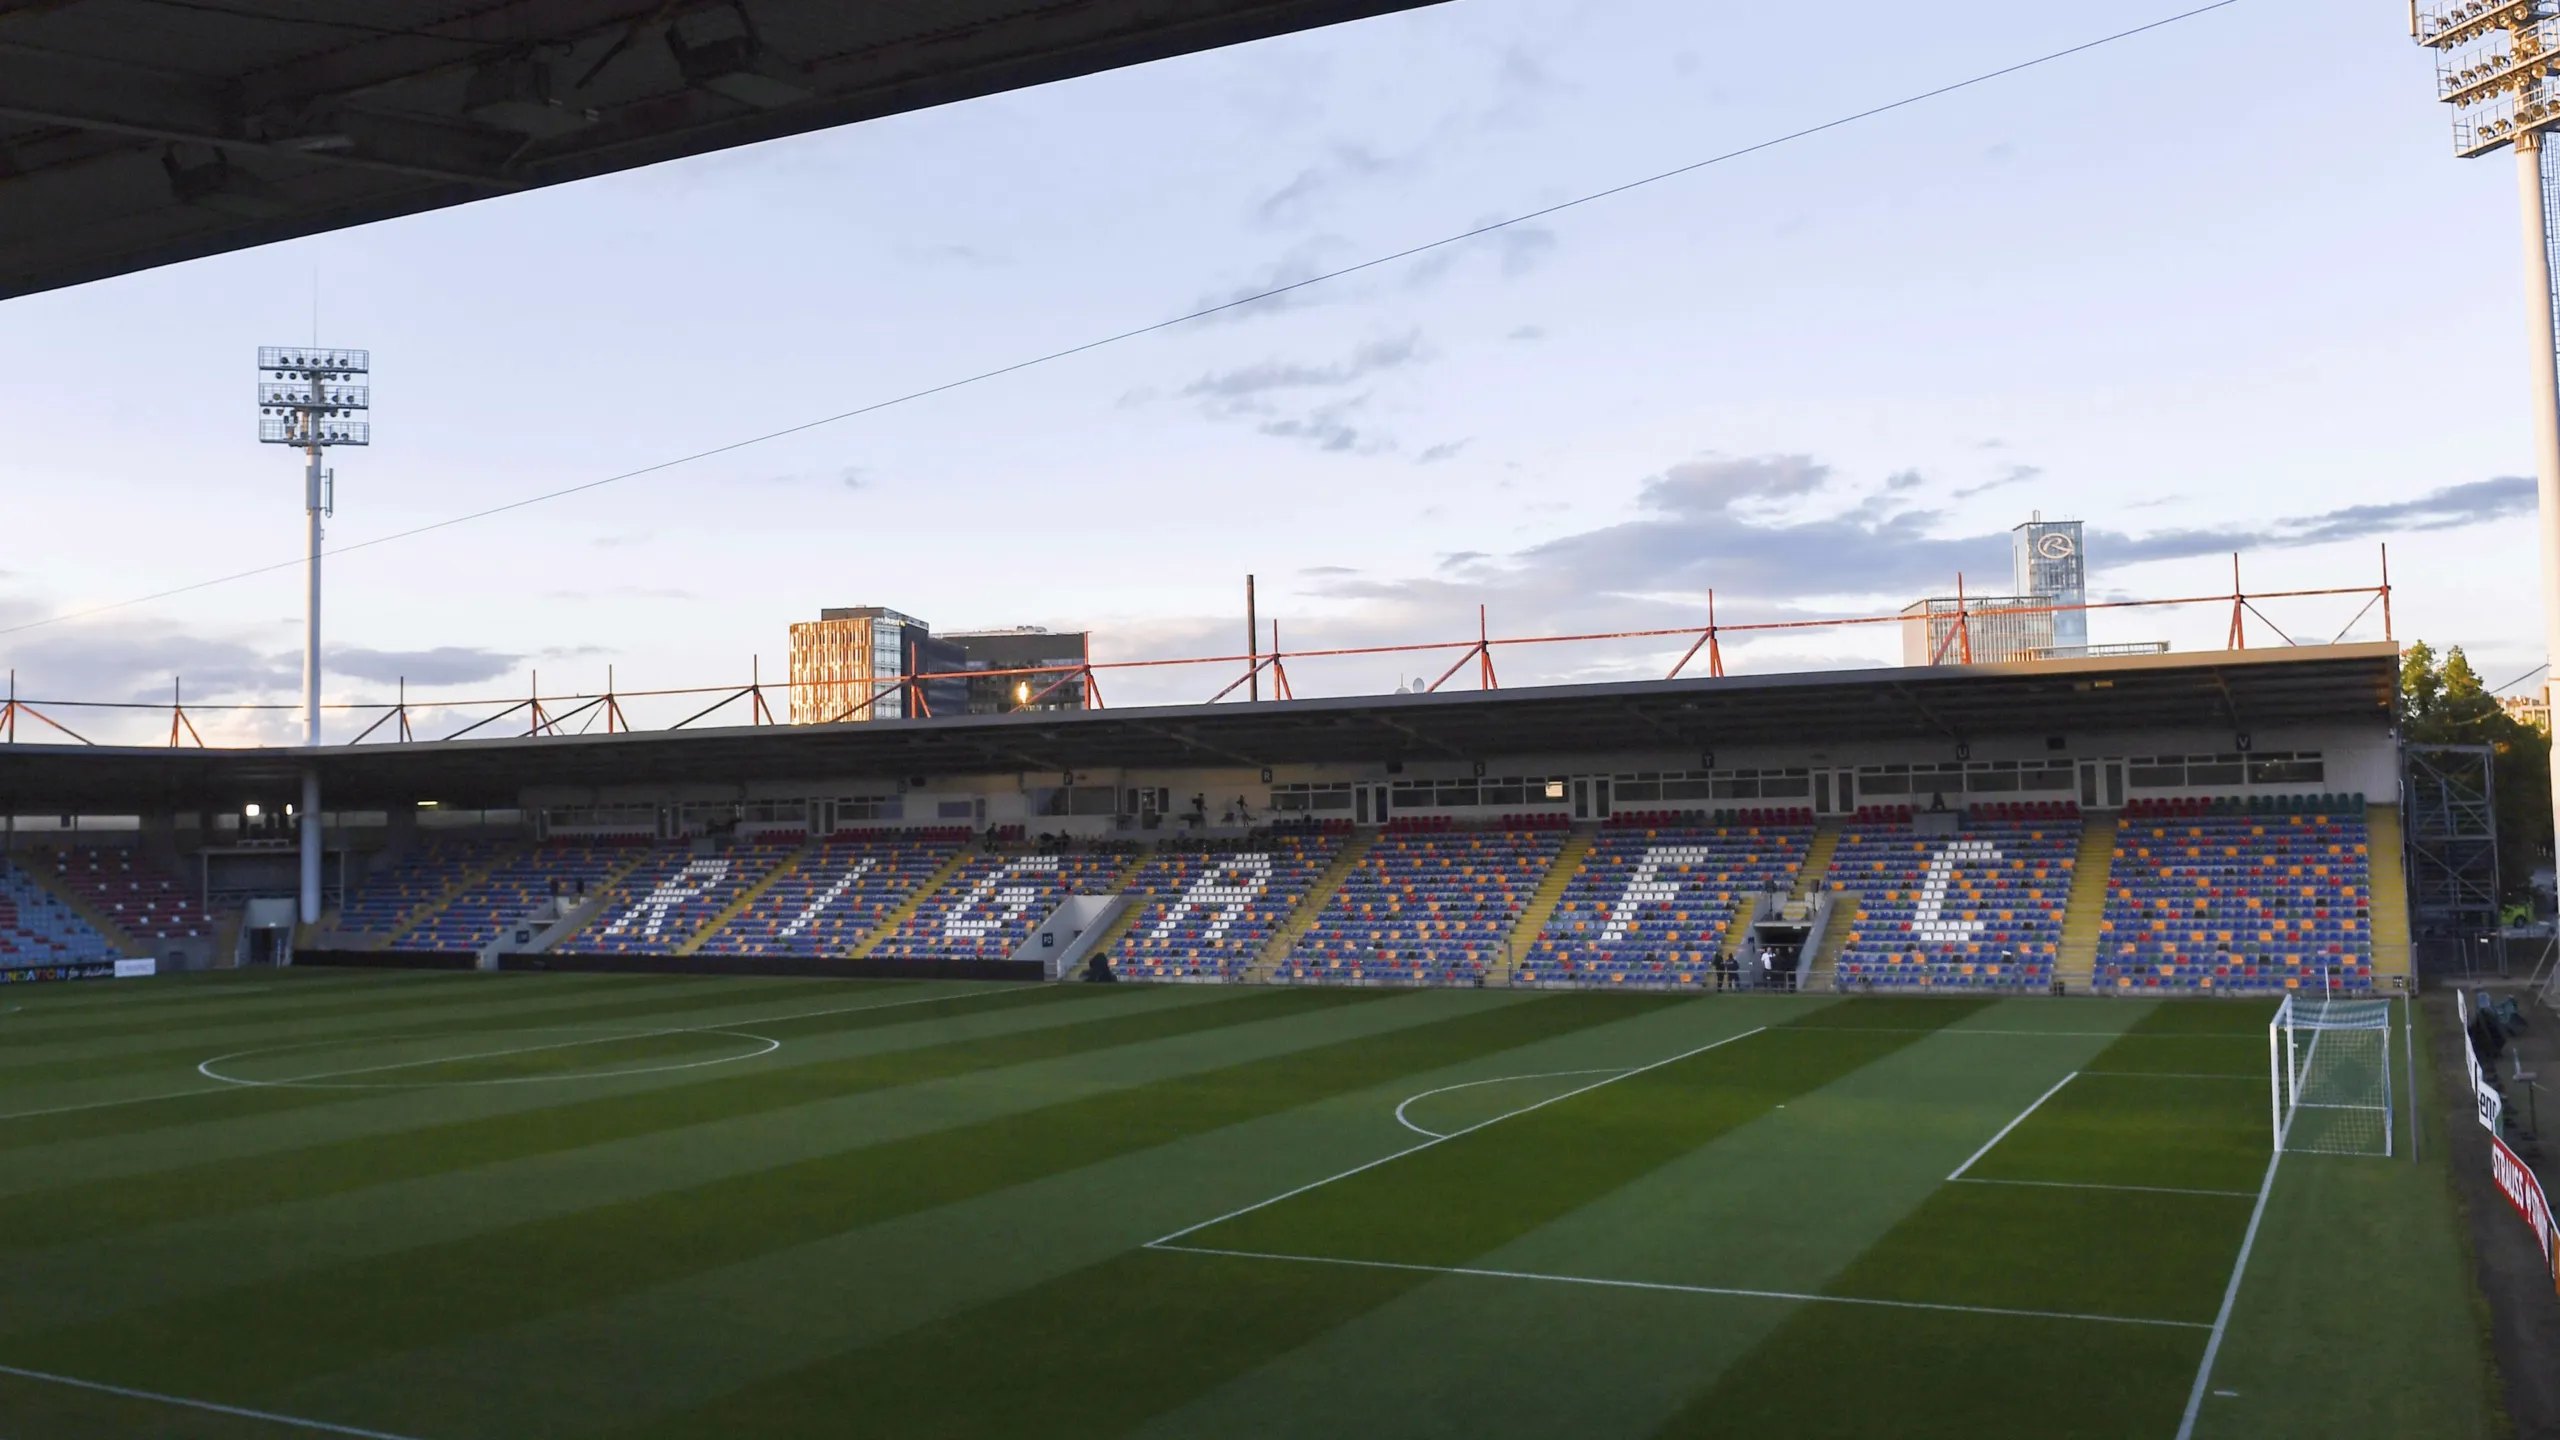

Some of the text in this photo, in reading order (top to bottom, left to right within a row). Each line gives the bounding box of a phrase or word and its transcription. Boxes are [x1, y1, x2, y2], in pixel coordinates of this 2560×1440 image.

[2239, 736, 2248, 748] V
[1958, 746, 1968, 758] U
[1704, 755, 1712, 767] T
[1601, 842, 2003, 941] FC
[2492, 1143, 2525, 1210] STRAUSS
